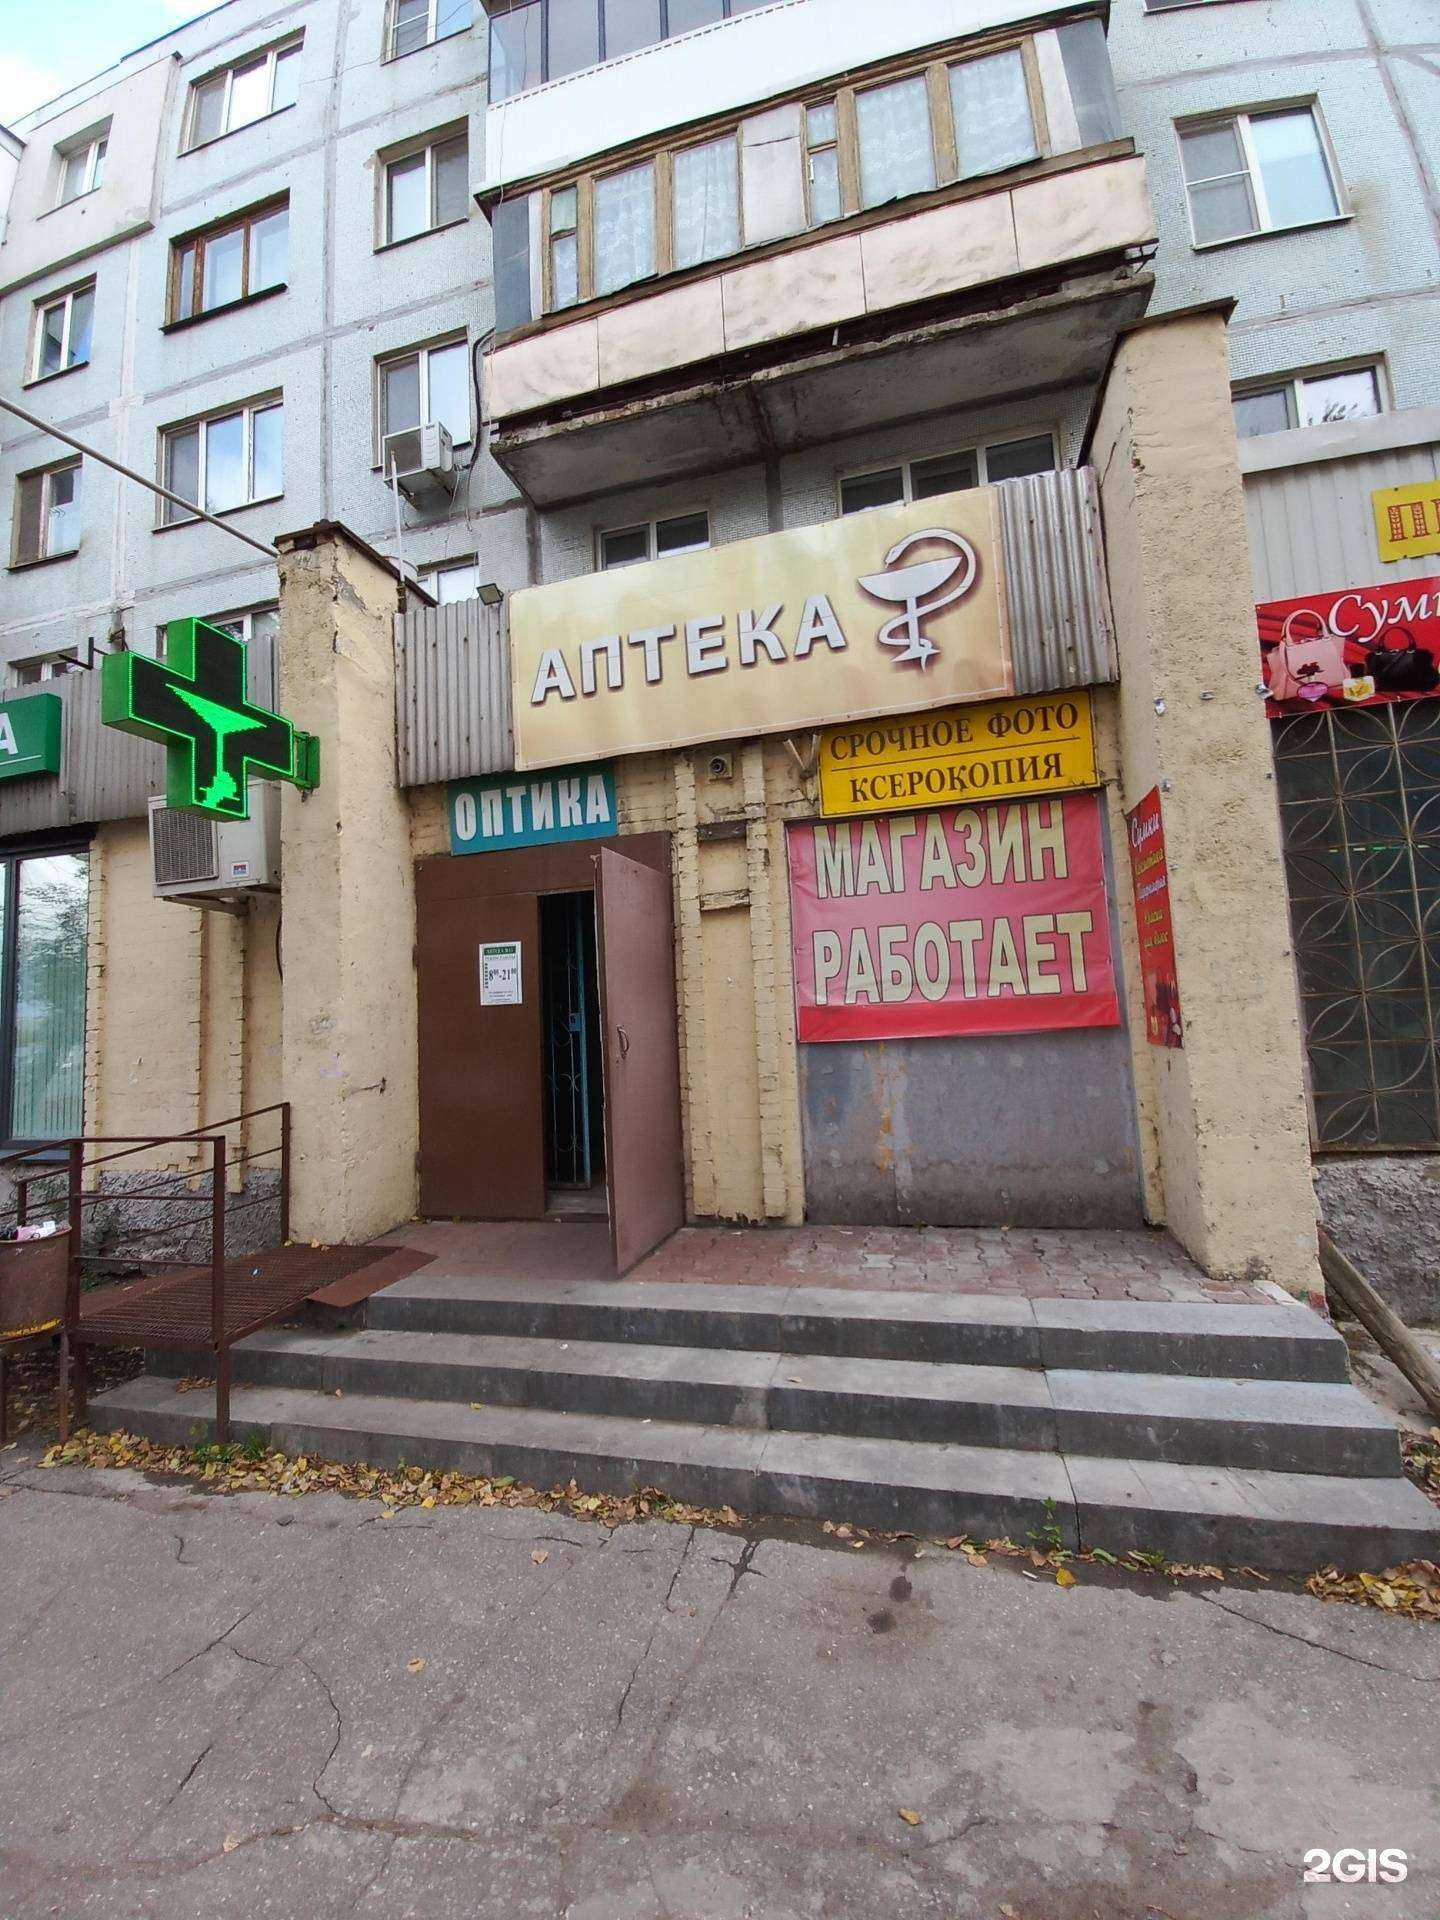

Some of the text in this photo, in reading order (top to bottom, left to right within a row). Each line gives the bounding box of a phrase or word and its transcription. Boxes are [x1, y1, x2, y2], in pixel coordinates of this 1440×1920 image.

[531, 594, 848, 705] АПТЕКА
[830, 702, 1079, 761] СРОЧНОЕ ФОТО
[454, 774, 611, 841] ОПТИКА
[850, 752, 1063, 803] КСЕРОКОПИЯ
[812, 799, 1069, 900] МАГАЗИН
[812, 910, 1093, 1006] РАБОТАЕТ
